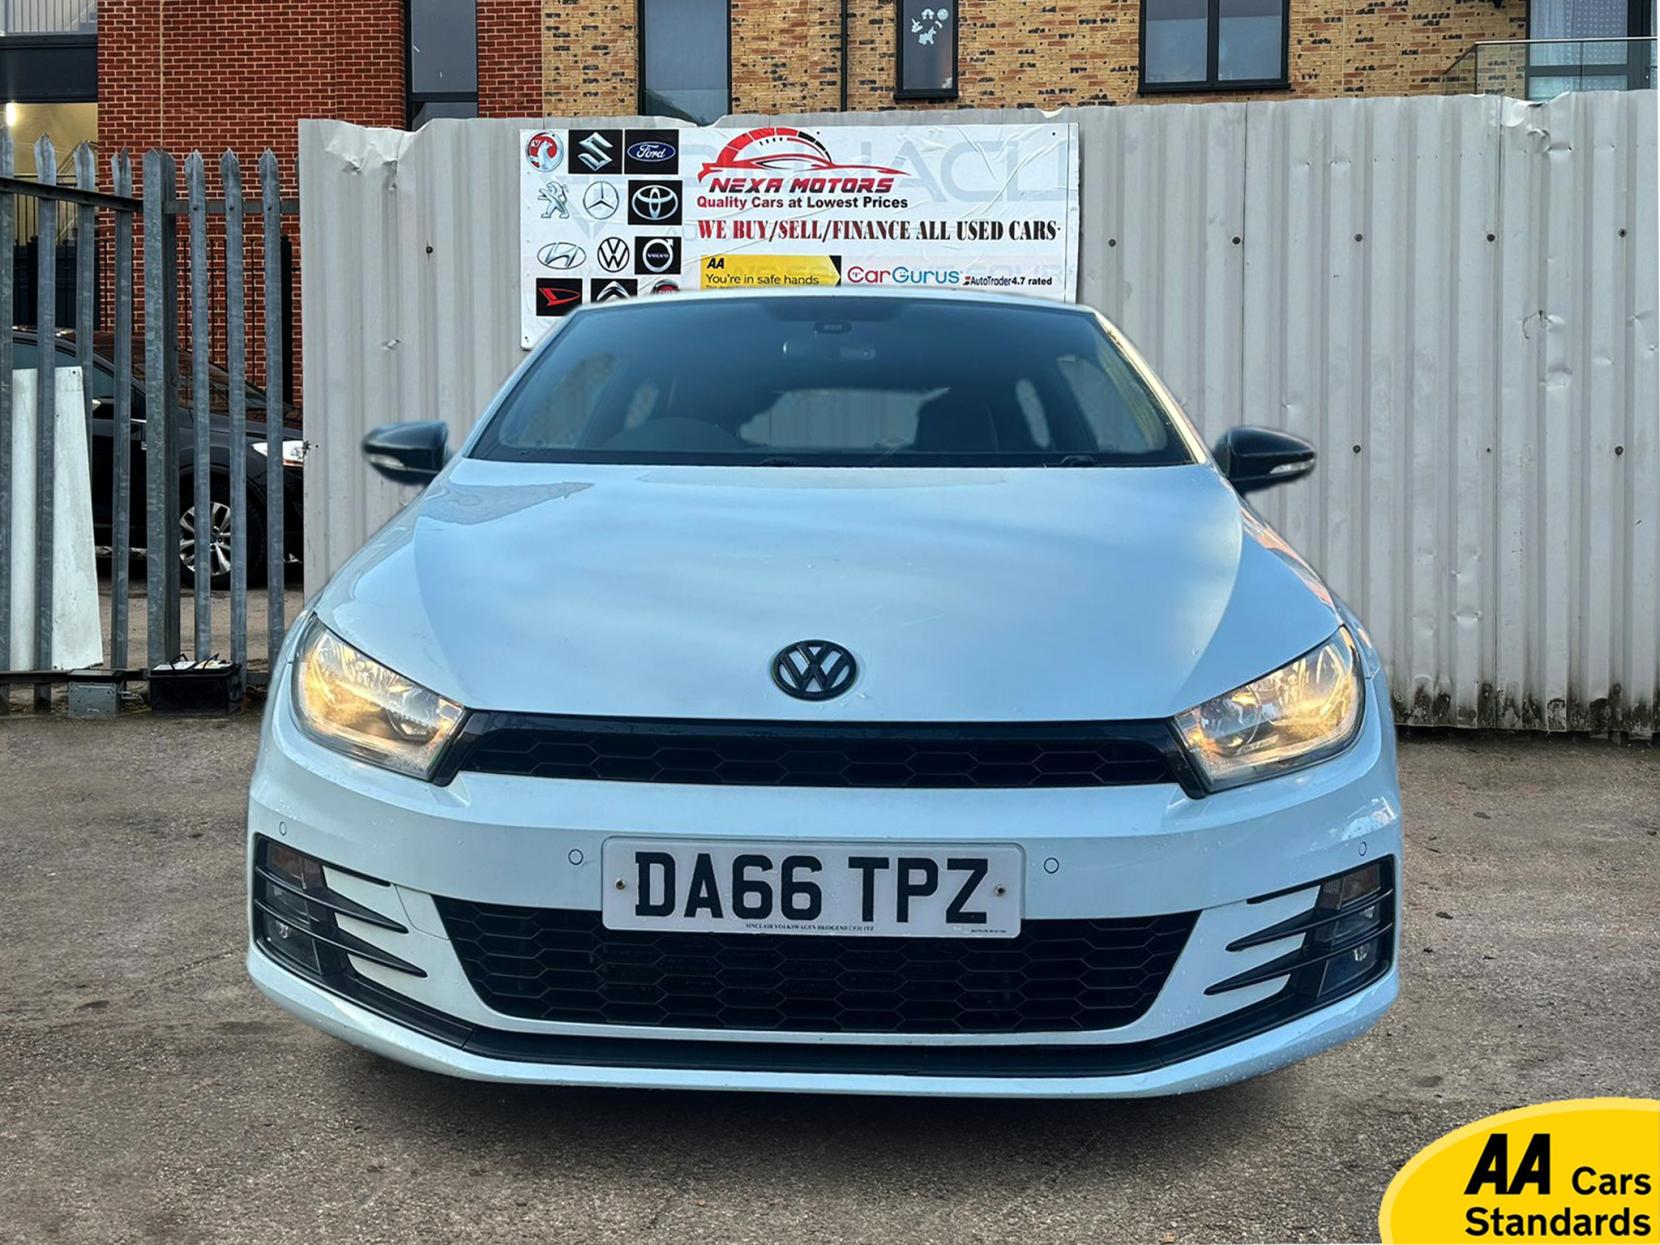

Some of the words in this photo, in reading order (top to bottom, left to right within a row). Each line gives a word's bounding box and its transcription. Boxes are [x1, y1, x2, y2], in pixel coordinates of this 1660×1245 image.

[636, 144, 666, 158] Ford
[709, 178, 784, 193] NEXA
[789, 178, 895, 193] MOTORS
[697, 196, 747, 211] Quality
[752, 196, 784, 208] Cars
[788, 197, 803, 208] at
[807, 196, 858, 208] Lowest
[863, 196, 908, 208] Prices
[697, 220, 726, 239] WE
[916, 220, 950, 240] ALL
[956, 220, 1004, 240] USED
[1008, 220, 1057, 241] CARS
[706, 257, 725, 269] AA
[706, 273, 741, 284] You're
[744, 274, 754, 284] in
[757, 274, 782, 285] safe
[784, 274, 819, 286] hands
[847, 266, 960, 284] CarGurus
[1028, 277, 1053, 286] rated
[635, 851, 823, 921] DA66
[848, 856, 989, 924] TPZ
